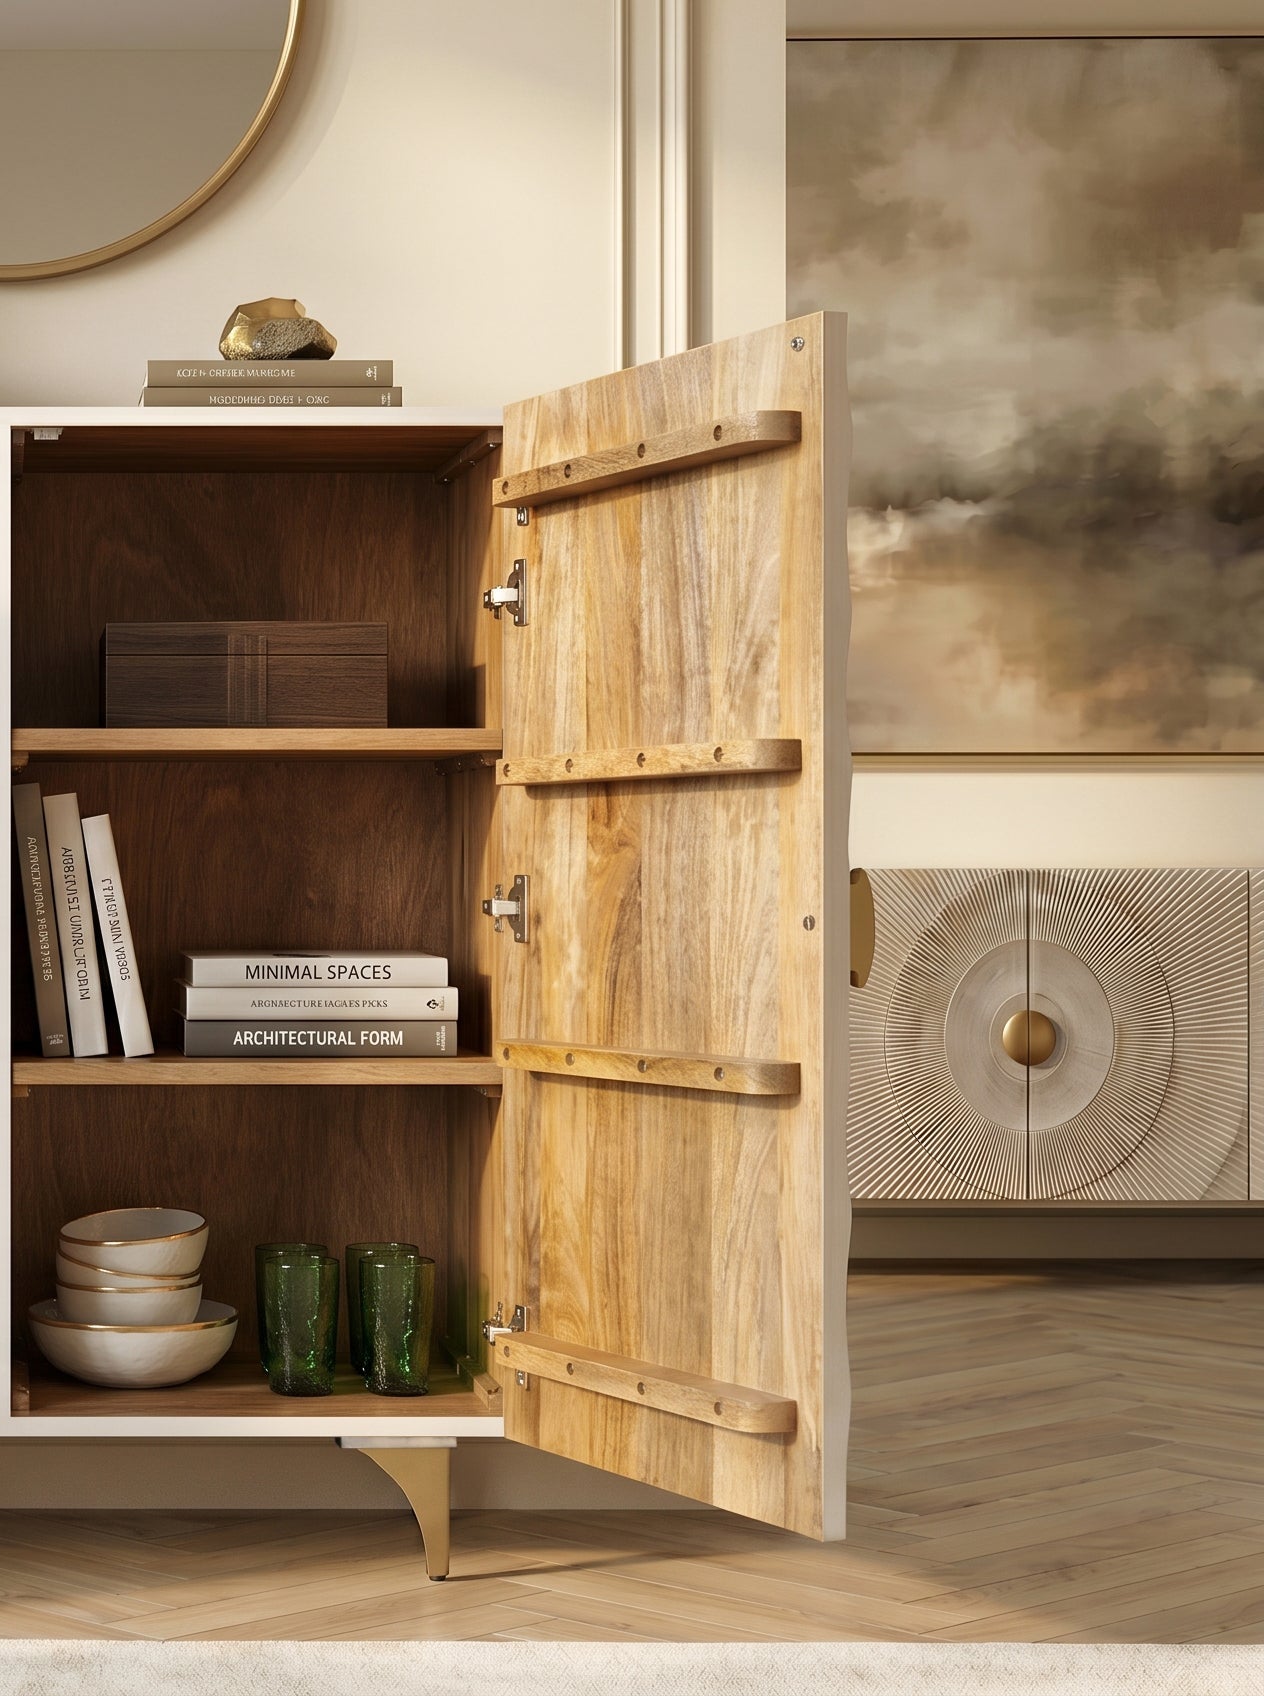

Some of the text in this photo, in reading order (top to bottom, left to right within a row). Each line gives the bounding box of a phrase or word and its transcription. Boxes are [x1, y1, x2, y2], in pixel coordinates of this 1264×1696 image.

[245, 965, 392, 980] MINIMAL SPACES
[233, 1031, 404, 1046] ARCHITECTURAL FORM
